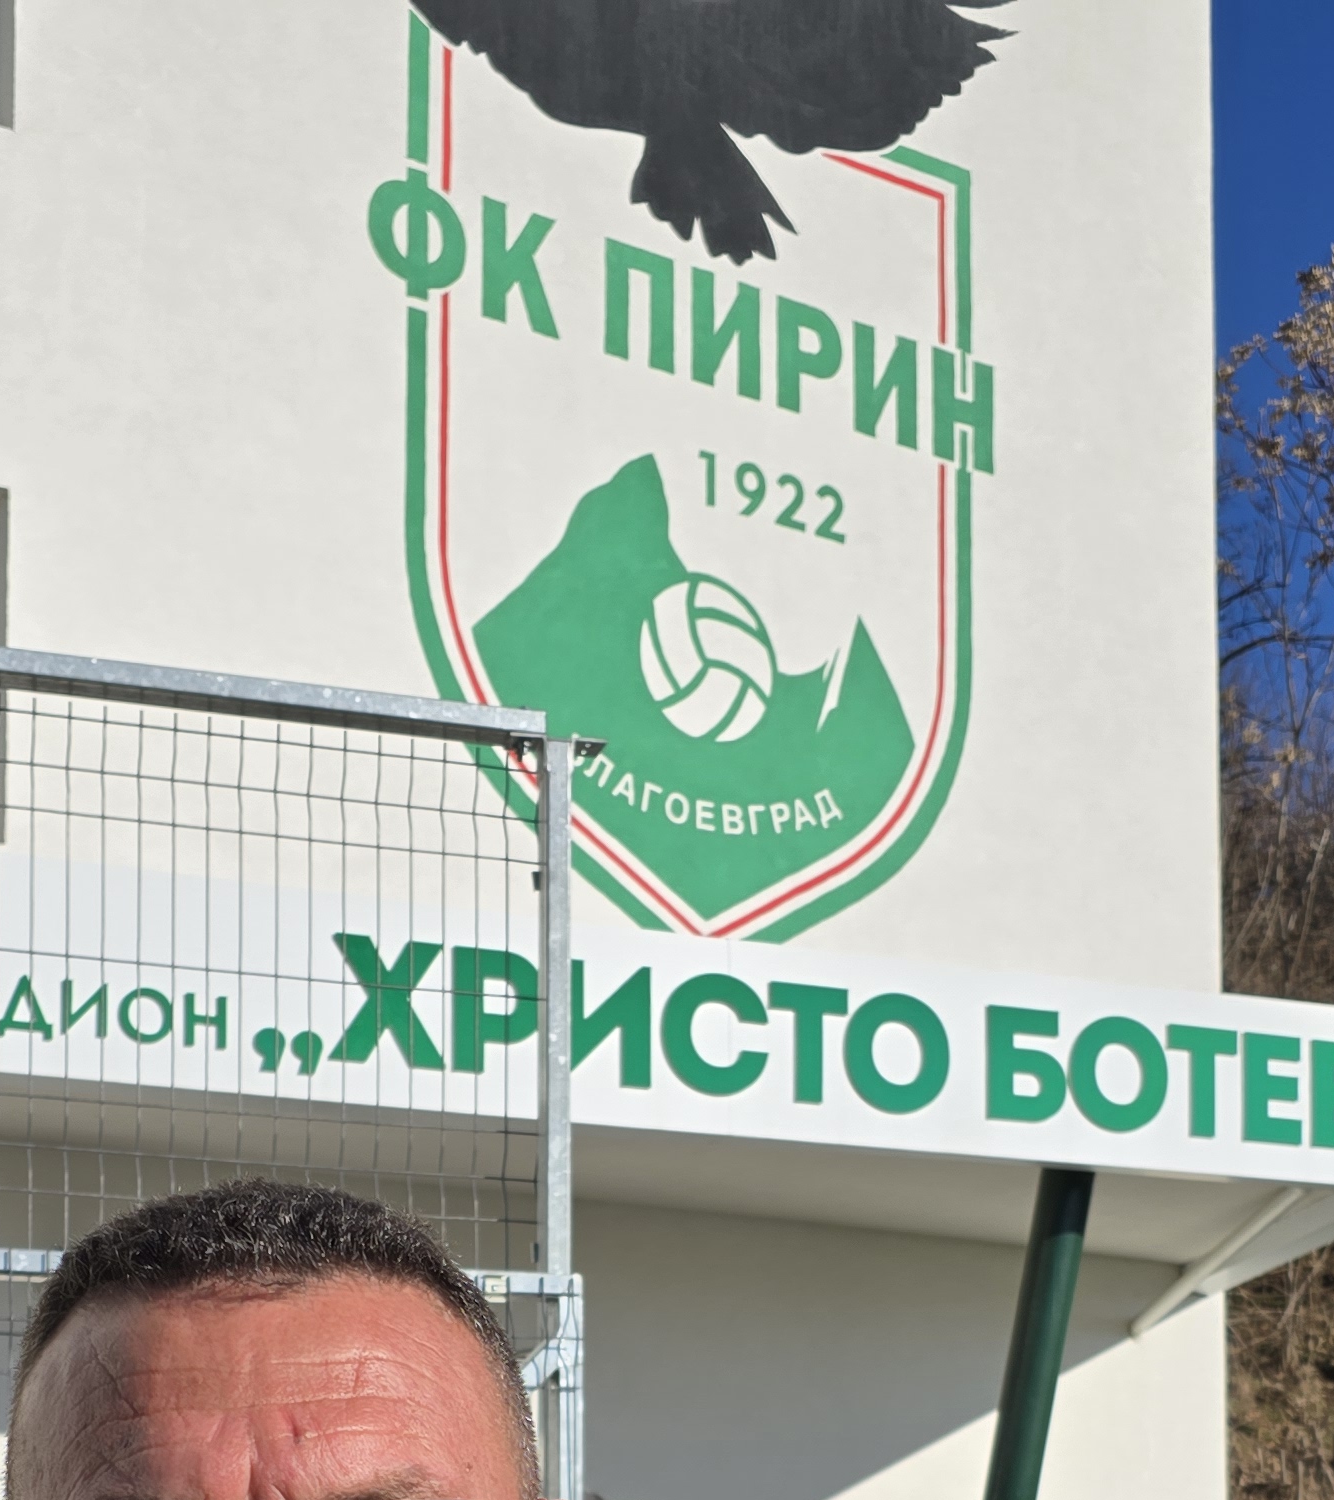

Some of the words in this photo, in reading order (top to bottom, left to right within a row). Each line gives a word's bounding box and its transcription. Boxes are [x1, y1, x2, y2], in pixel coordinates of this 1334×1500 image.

[367, 167, 560, 341] ФК
[603, 237, 995, 475] ПИРИН
[698, 450, 846, 545] 1922
[571, 750, 844, 836] ЛАГОЕВГРАД
